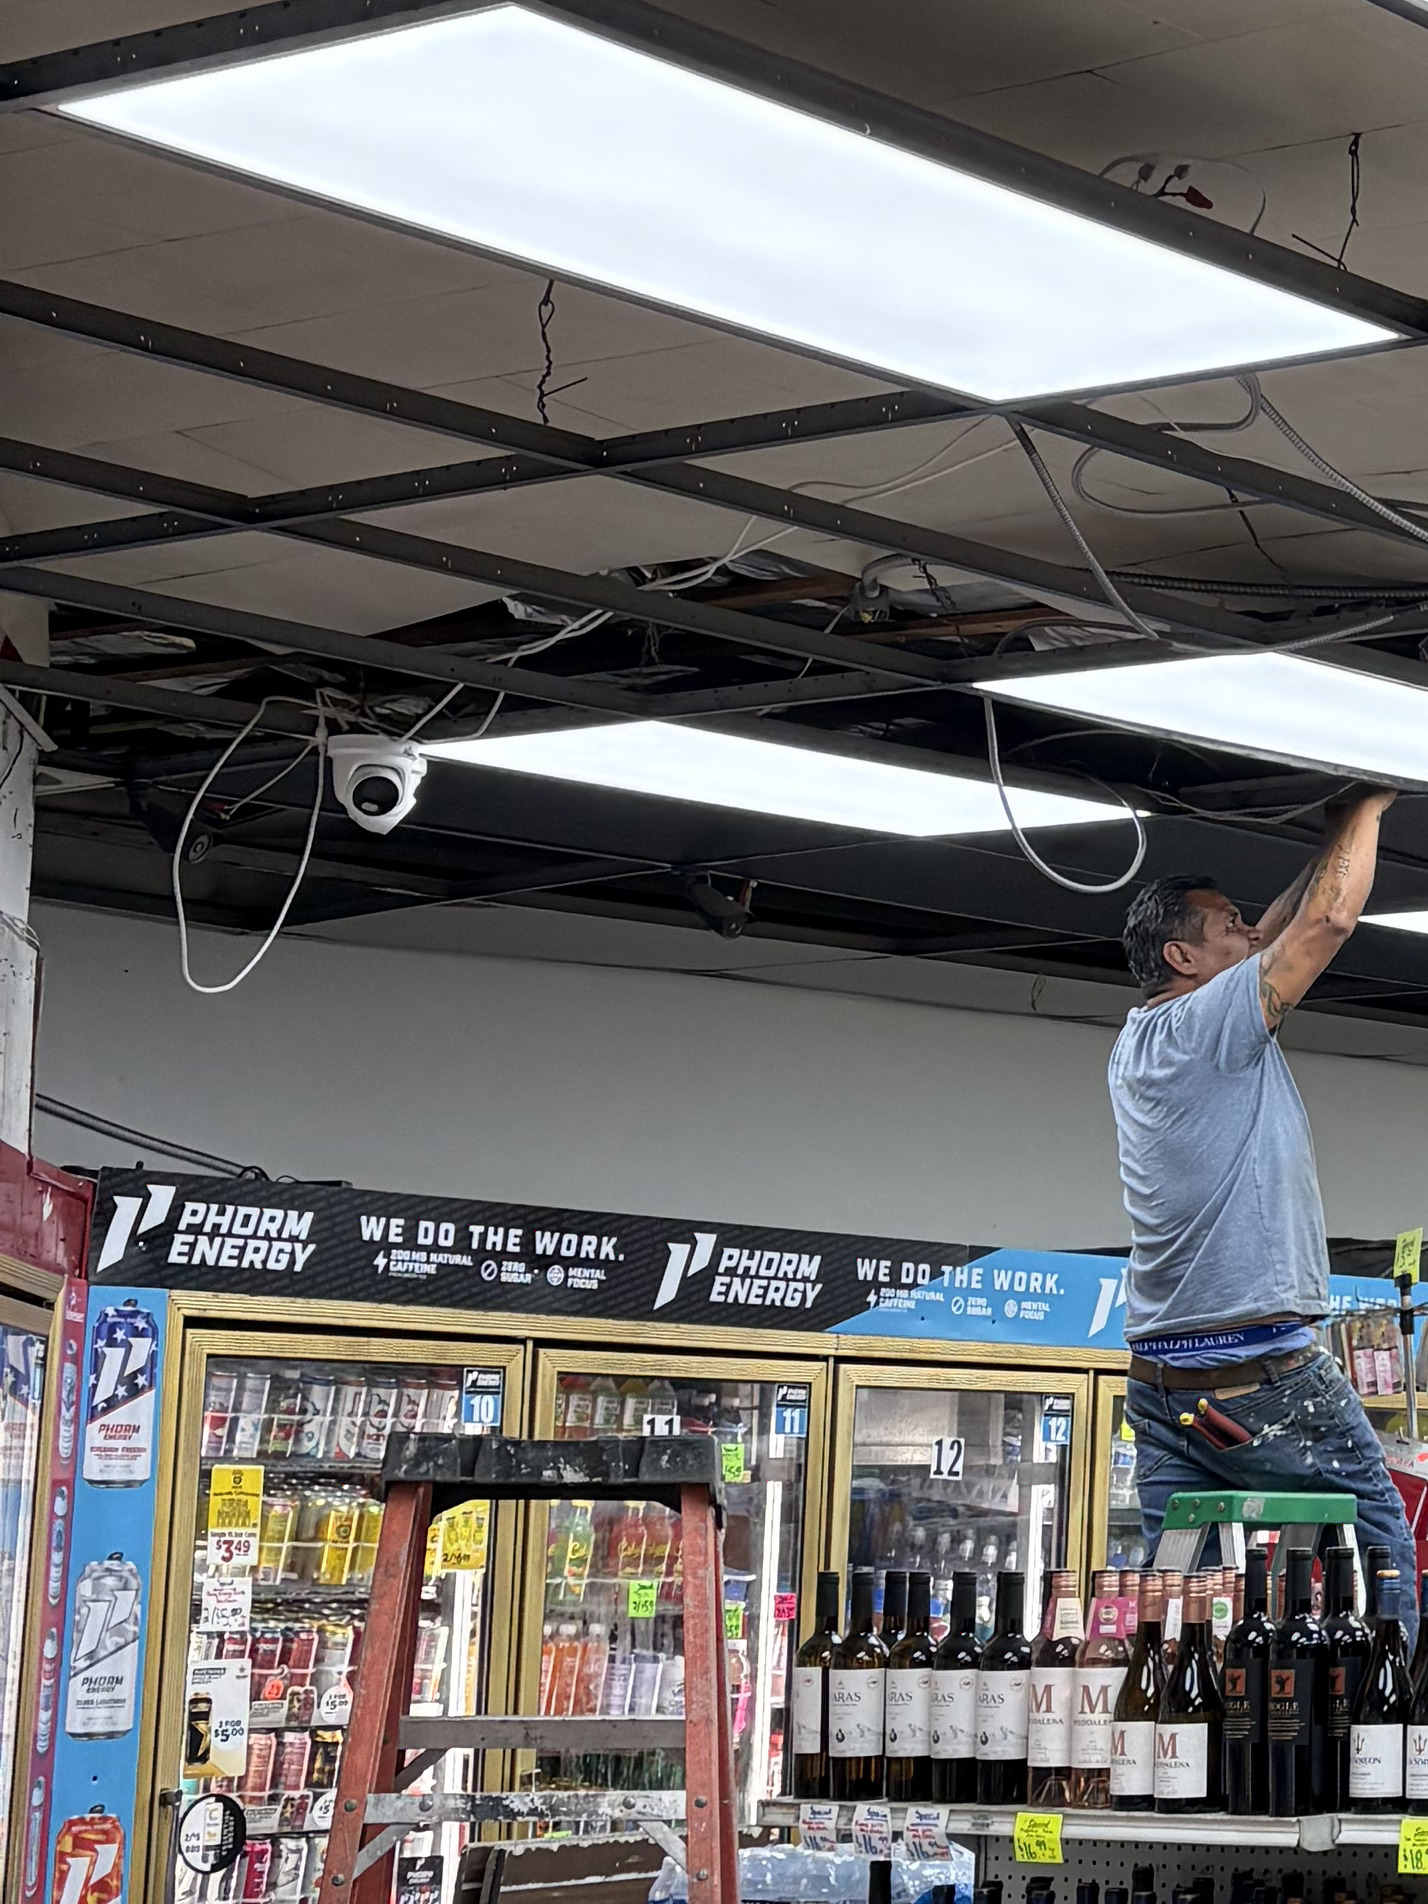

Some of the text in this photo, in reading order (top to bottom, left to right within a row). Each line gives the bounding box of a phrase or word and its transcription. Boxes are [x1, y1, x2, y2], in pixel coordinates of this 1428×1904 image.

[177, 1202, 314, 1238] PHORM
[360, 1215, 624, 1261] WE DO THE WORK.
[168, 1234, 316, 1272] ENERGY
[501, 1261, 525, 1272] ZERO
[718, 1248, 822, 1281] PHORM
[567, 1278, 598, 1289] FOCUS
[568, 1268, 606, 1280] MENTAL
[856, 1258, 1065, 1295] WE DO THE WORK.
[709, 1275, 823, 1309] ENERGY
[470, 1396, 494, 1424] 10
[782, 1409, 801, 1433] 11
[98, 1423, 140, 1435] PHORM
[646, 1417, 675, 1436] 11
[1047, 1417, 1067, 1443] 12
[932, 1438, 962, 1478] 12
[81, 1675, 123, 1687] PHORM
[1031, 1684, 1056, 1712] M
[1081, 1684, 1112, 1714] M
[1158, 1732, 1179, 1759] M
